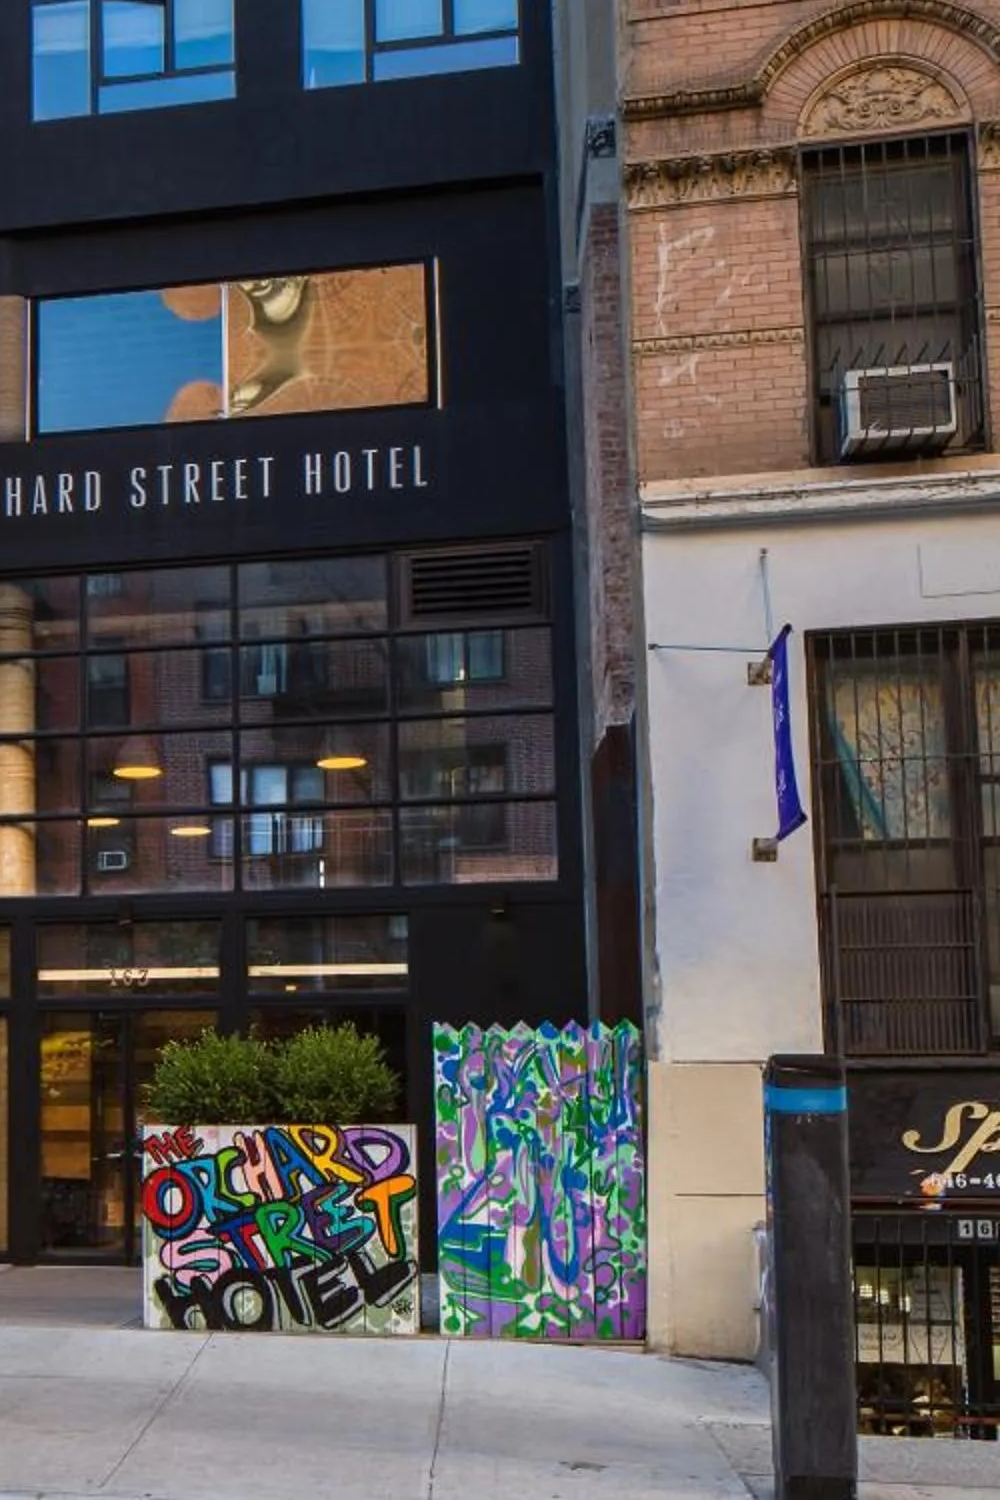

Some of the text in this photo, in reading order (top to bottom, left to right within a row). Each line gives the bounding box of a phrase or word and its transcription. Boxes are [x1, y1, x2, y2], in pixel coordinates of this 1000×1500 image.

[130, 456, 275, 507] STREET
[304, 445, 428, 495] HOTEL
[142, 1124, 411, 1241] ORCHARD
[143, 1124, 204, 1165] THE
[160, 1173, 416, 1285] STREET
[153, 1251, 419, 1331] HOTEL
